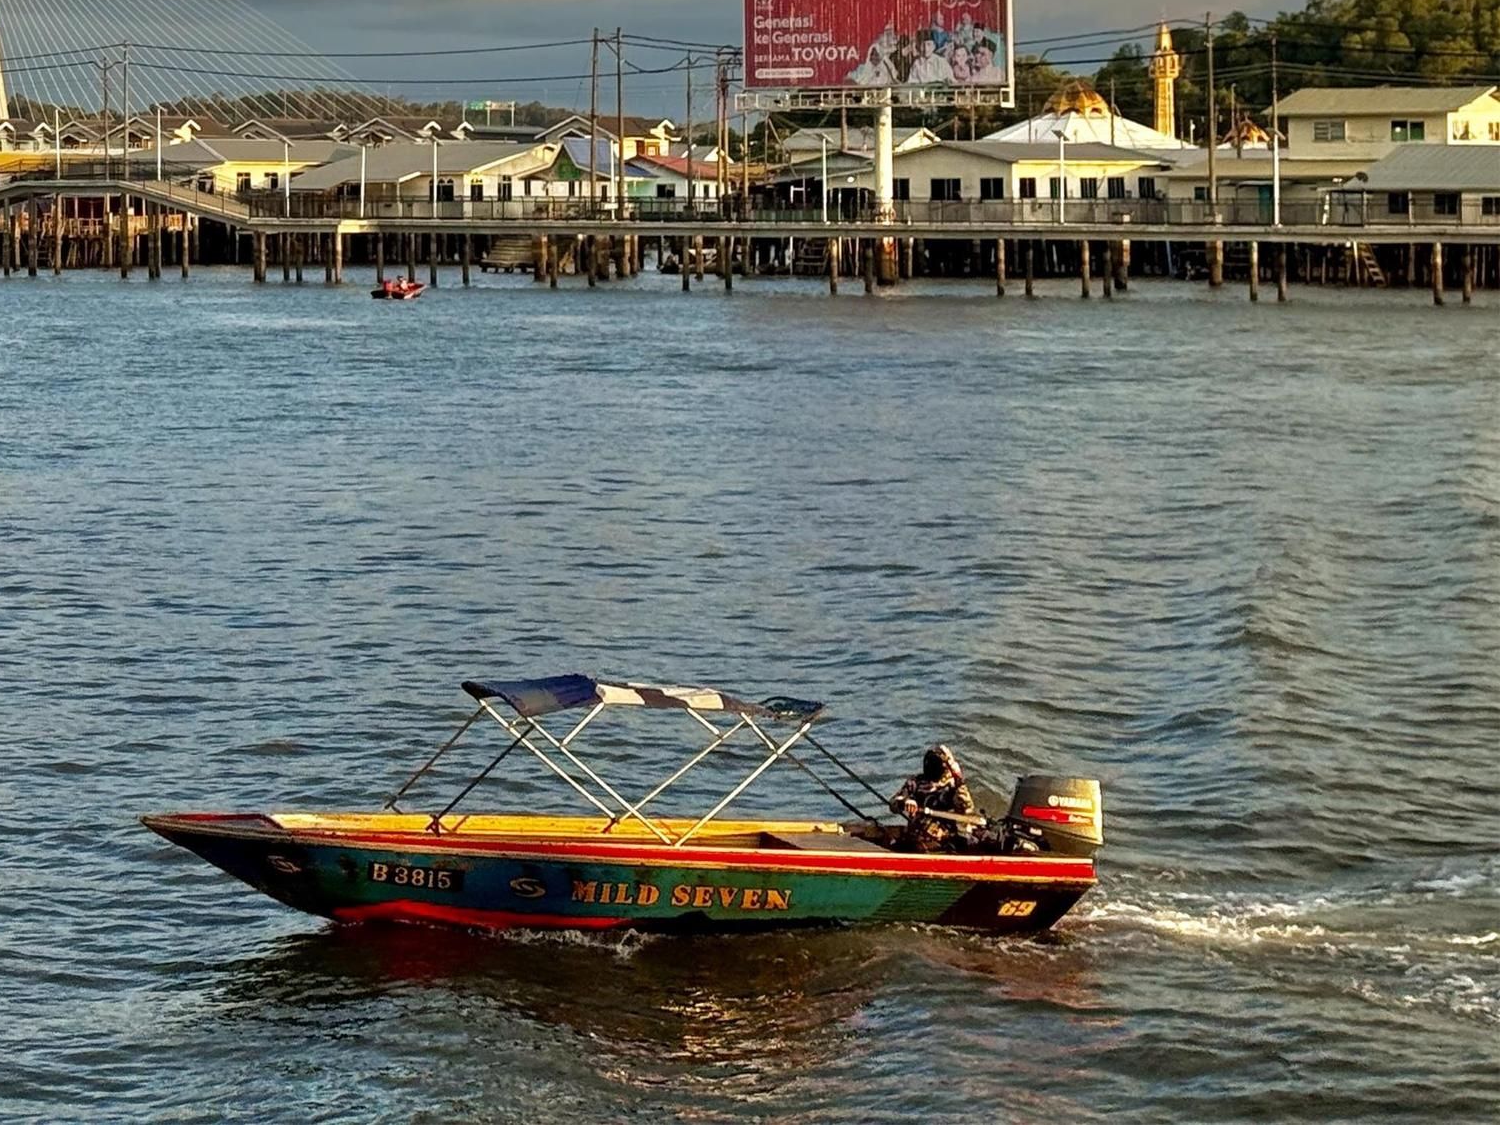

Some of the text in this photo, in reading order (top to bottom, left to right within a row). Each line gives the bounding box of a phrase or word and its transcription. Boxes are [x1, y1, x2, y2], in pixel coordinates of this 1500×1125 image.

[754, 14, 813, 28] Generasi
[755, 30, 832, 44] ke Generasi
[792, 46, 859, 61] TOYOTA
[373, 863, 452, 889] B 3815
[572, 880, 792, 910] MILD SEVEN
[998, 900, 1037, 916] 69
